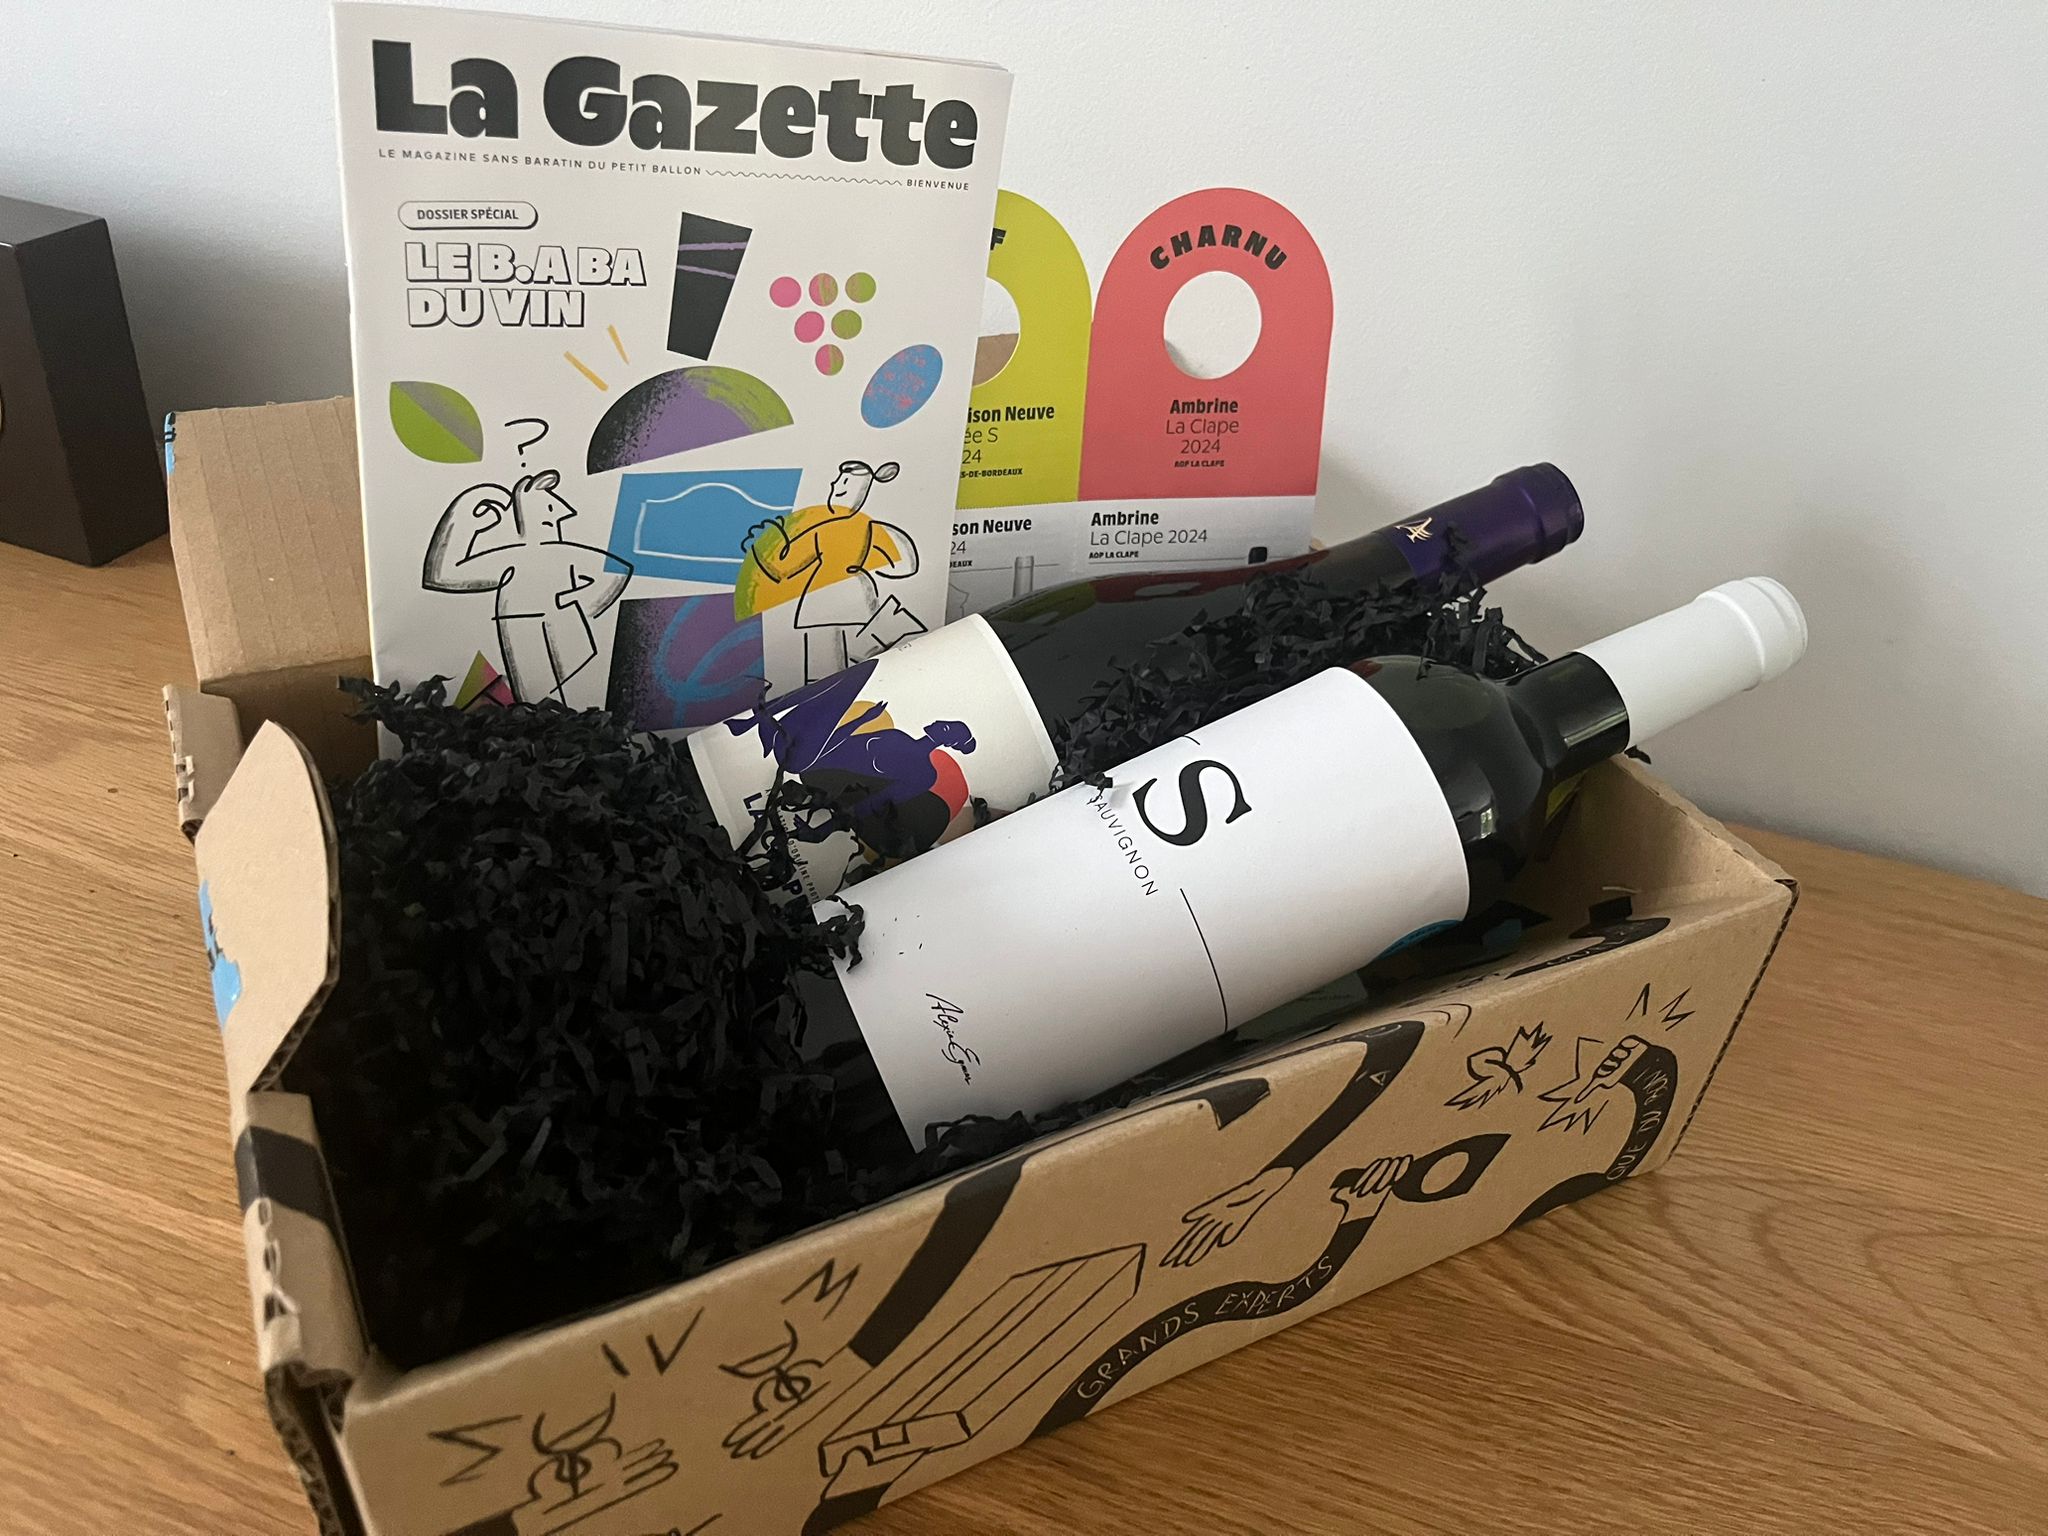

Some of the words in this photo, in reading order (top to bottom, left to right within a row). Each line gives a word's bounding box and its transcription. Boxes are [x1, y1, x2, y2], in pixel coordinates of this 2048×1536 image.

[372, 39, 518, 139] La
[543, 56, 977, 169] Gazette
[379, 149, 395, 158] LE
[402, 150, 476, 162] MAGAZINE
[483, 154, 519, 165] SANS
[525, 156, 582, 168] BARATIN
[589, 161, 606, 170] DU
[612, 162, 646, 172] PETIT
[652, 165, 701, 175] BALLON
[906, 179, 970, 190] BIENVENUE
[417, 209, 468, 220] DOSSIER
[471, 206, 519, 220] SPÉCIAL
[1150, 224, 1287, 270] CHARNU
[405, 241, 472, 283] LE
[478, 243, 572, 285] B.A
[577, 247, 647, 286] BA
[407, 288, 484, 327] DU
[489, 288, 584, 327] VIN
[1006, 406, 1055, 421] Neuve
[1170, 398, 1238, 414] Ambrine
[987, 427, 999, 443] S
[1166, 419, 1185, 434] La
[1190, 418, 1240, 437] Clape
[1180, 439, 1221, 454] 2024
[983, 519, 1032, 534] Neuve
[1091, 510, 1159, 526] Ambrine
[1090, 531, 1109, 545] La
[1114, 530, 1164, 547] Clape
[1168, 529, 1208, 544] 2024
[1116, 551, 1139, 559] CLAPE
[1132, 760, 1252, 846] S
[1087, 795, 1158, 895] SAUVIGNON
[1606, 1142, 1648, 1180] QUE
[1077, 1302, 1199, 1399] GRANDS
[1214, 1255, 1332, 1315] EXPERTS
